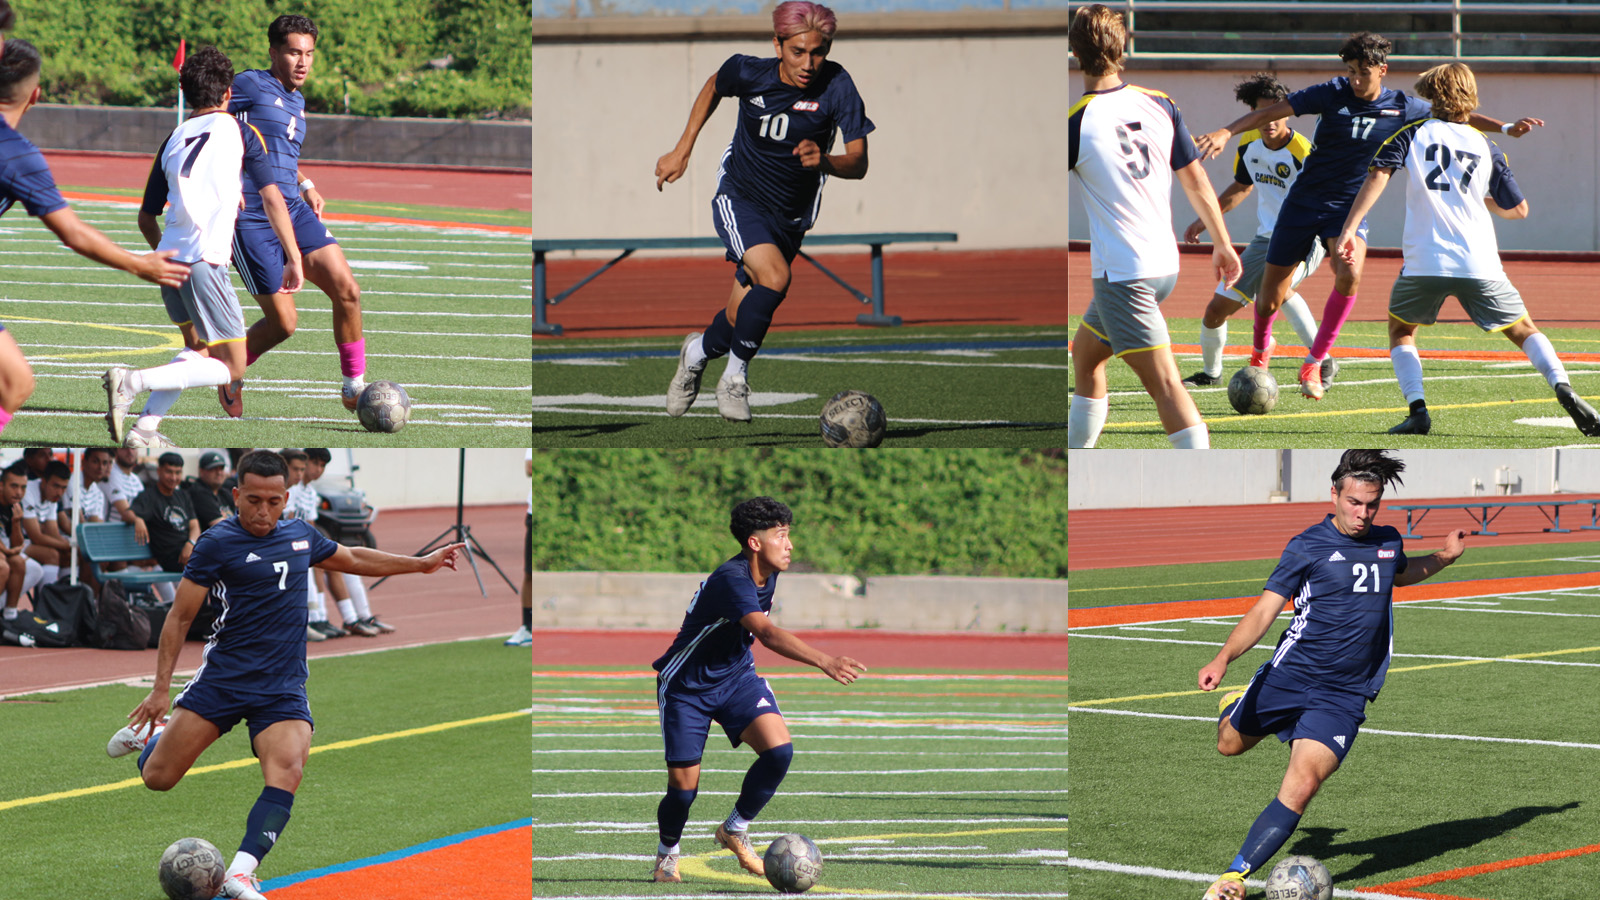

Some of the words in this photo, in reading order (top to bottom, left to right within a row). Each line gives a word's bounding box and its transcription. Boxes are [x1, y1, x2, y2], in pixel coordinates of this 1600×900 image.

[286, 116, 297, 140] 4
[759, 113, 789, 141] 10
[1351, 116, 1376, 140] 17
[180, 132, 211, 178] 7
[1115, 121, 1150, 180] 5
[1424, 143, 1481, 194] 27
[829, 397, 864, 418] SELECT
[273, 561, 289, 590] 7
[1352, 564, 1380, 593] 21
[177, 852, 213, 872] SELECT
